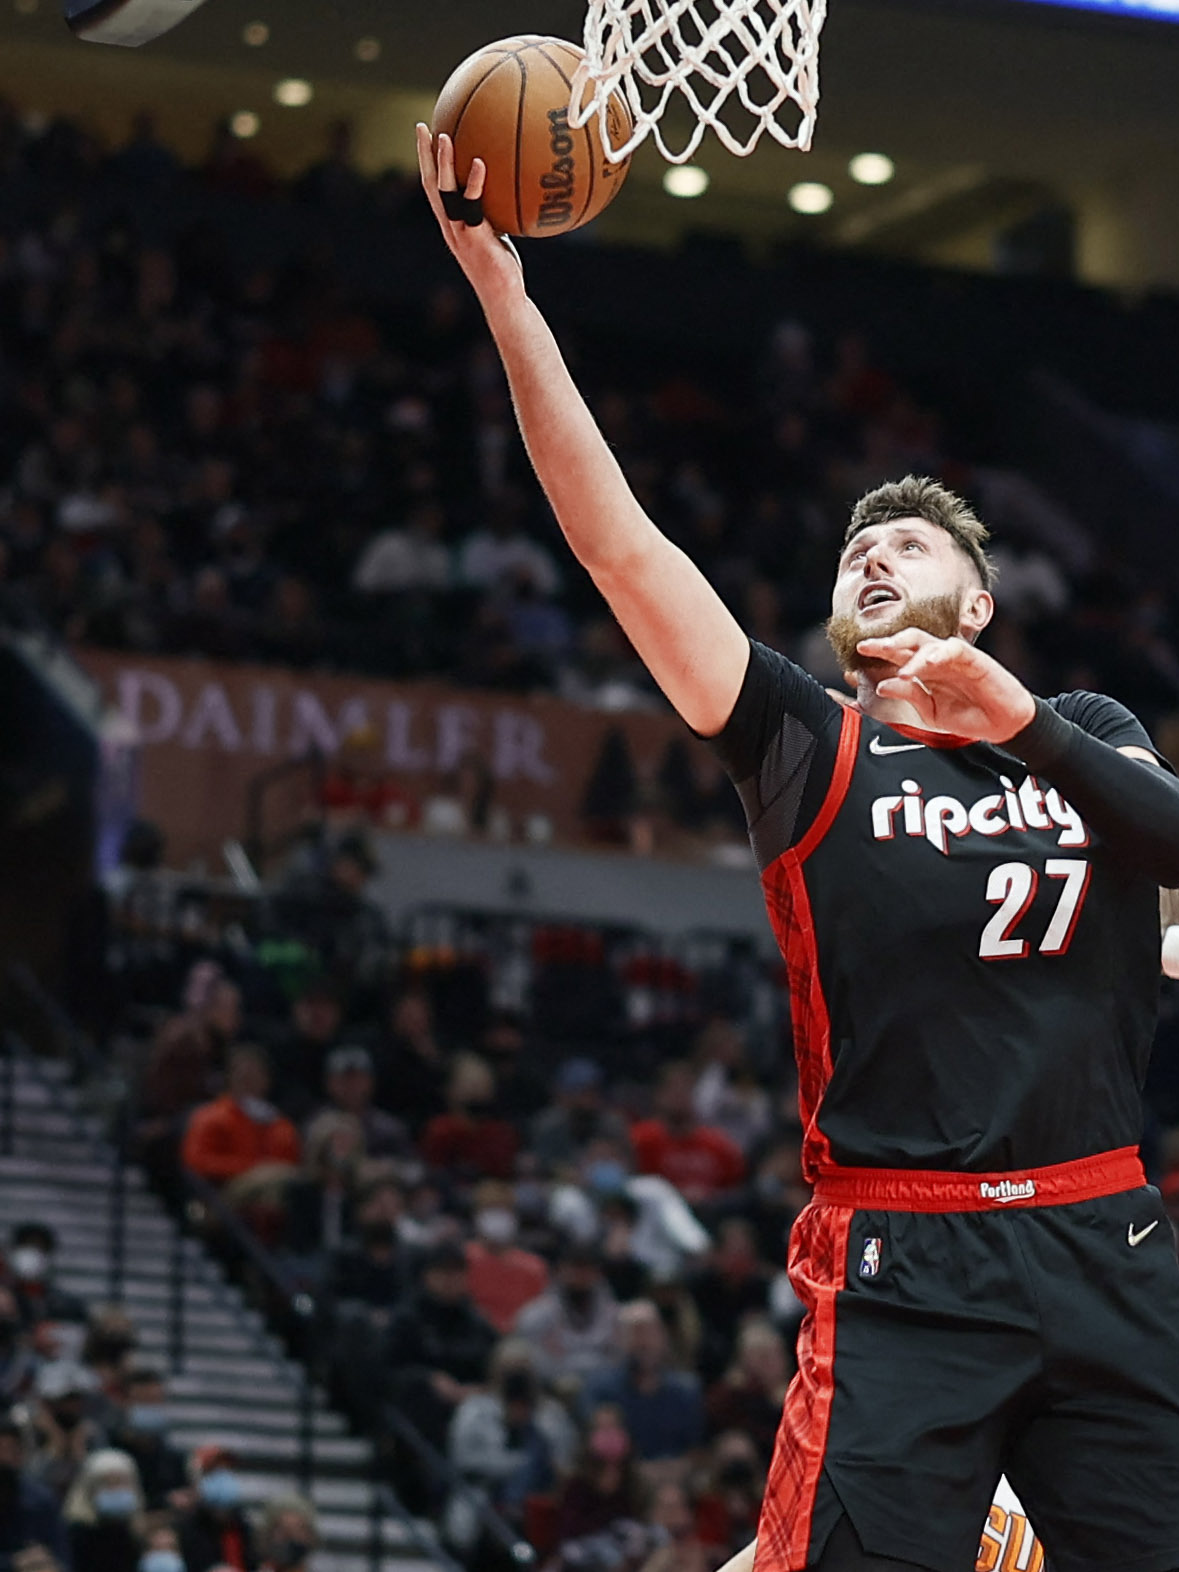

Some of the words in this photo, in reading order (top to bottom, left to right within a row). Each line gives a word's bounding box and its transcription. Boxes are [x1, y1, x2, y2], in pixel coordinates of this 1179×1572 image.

[537, 105, 574, 228] Wilson
[871, 775, 1091, 856] ripcity
[978, 858, 1092, 962] 27
[980, 1179, 1036, 1203] Portland
